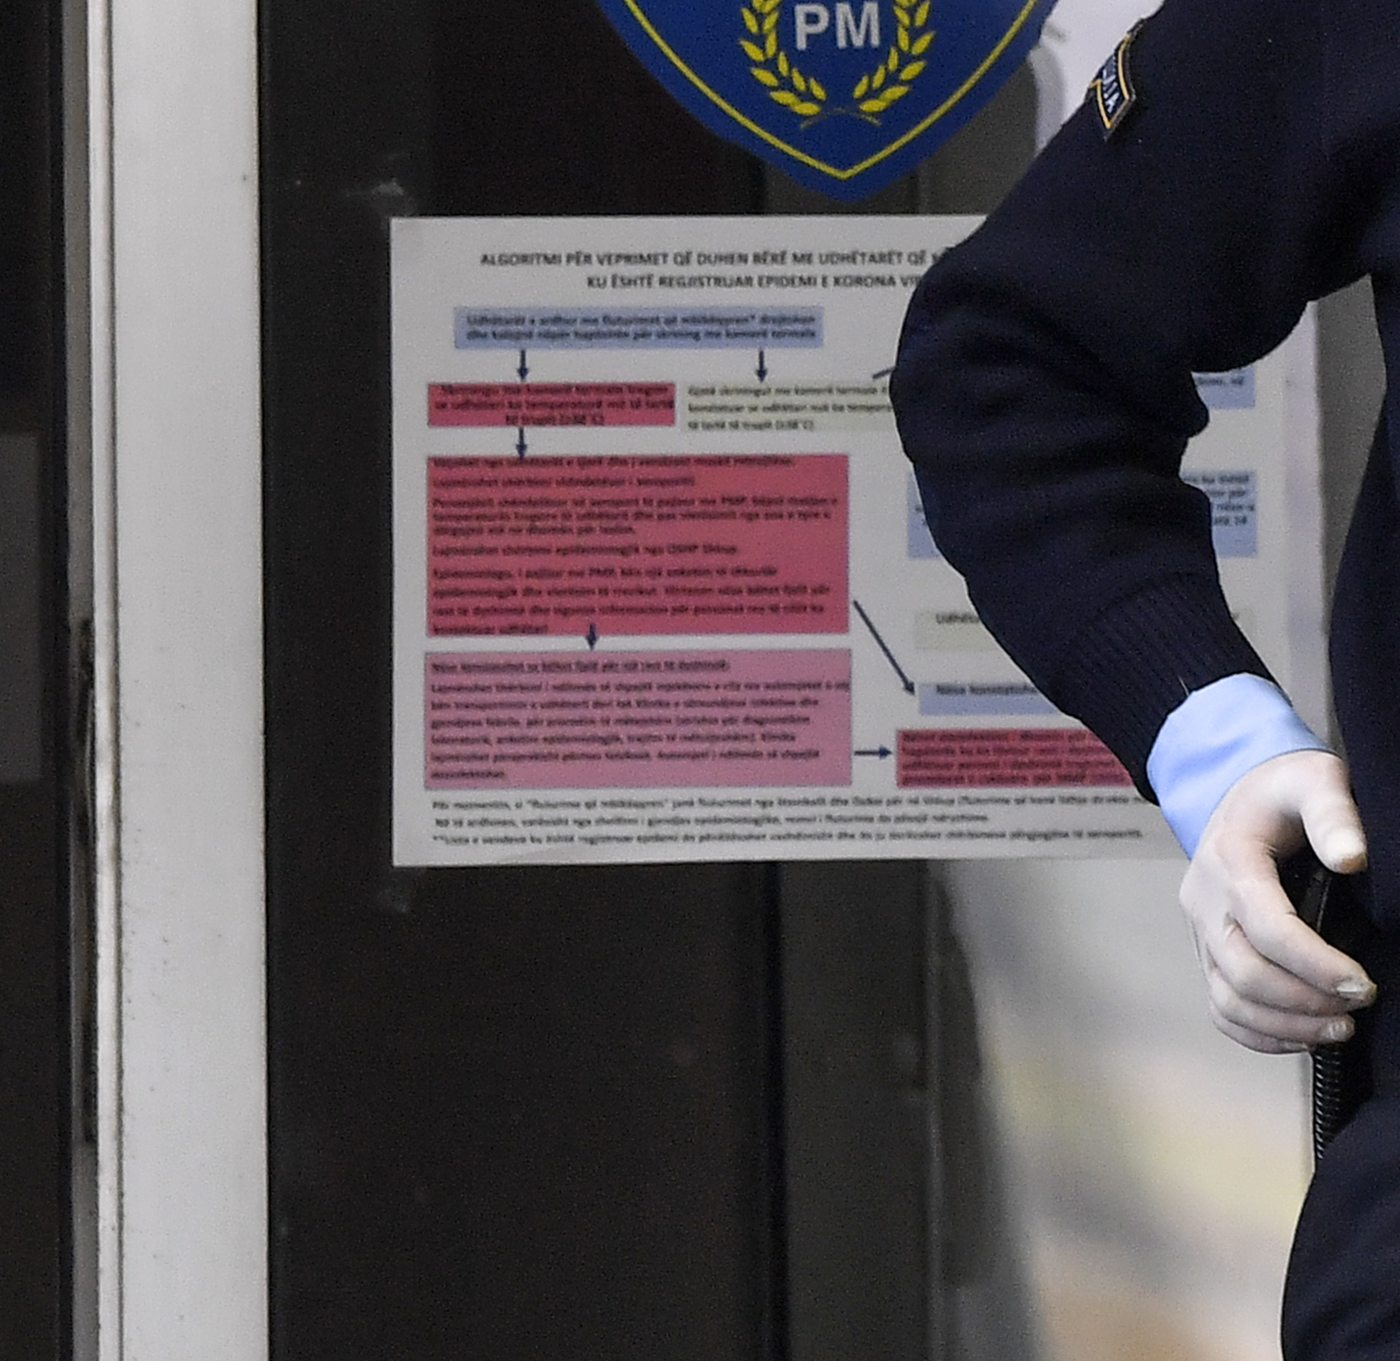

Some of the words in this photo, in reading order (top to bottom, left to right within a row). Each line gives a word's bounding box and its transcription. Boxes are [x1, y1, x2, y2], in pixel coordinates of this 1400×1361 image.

[480, 252, 563, 267] ALGORITMI
[566, 250, 593, 267] PËR
[597, 252, 669, 267] VEPRIMET
[696, 251, 749, 267] DUHEN
[792, 252, 814, 267] ME
[586, 275, 608, 289] KU
[757, 275, 818, 289] EPIDEMI
[832, 275, 898, 289] KORONA
